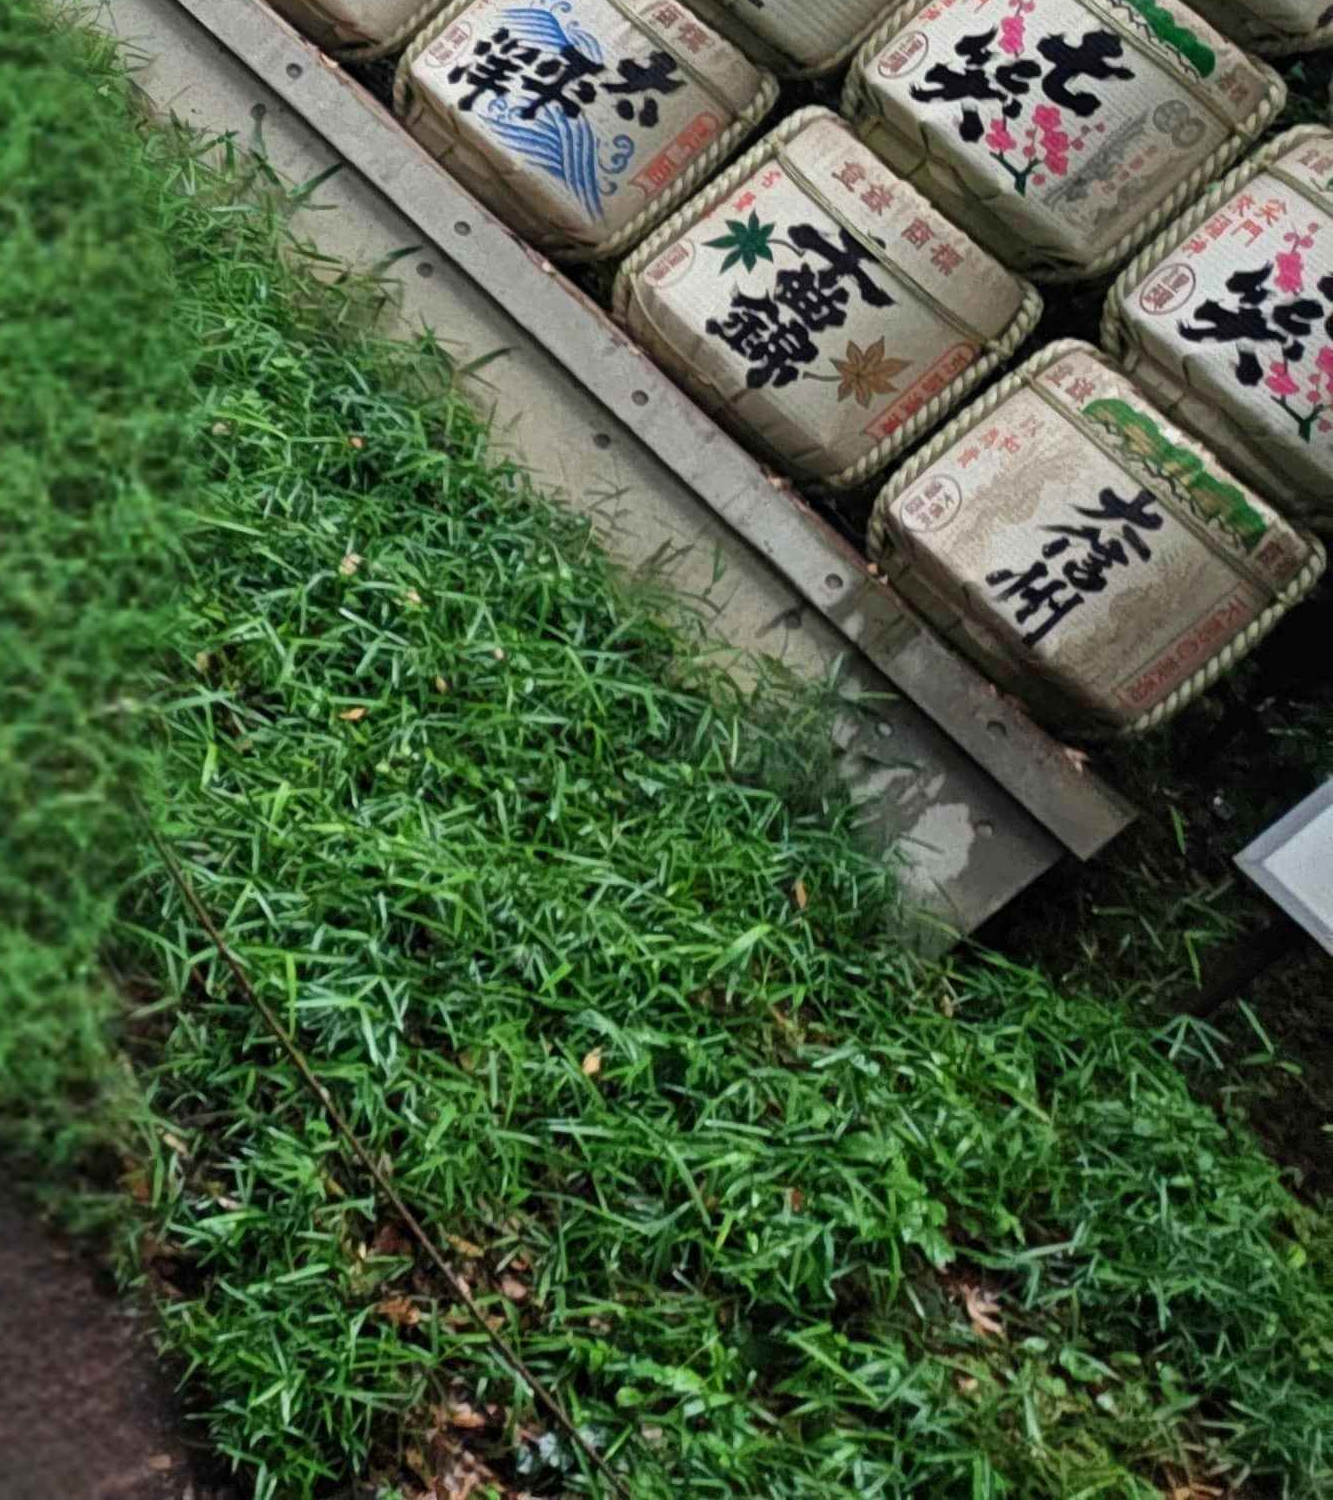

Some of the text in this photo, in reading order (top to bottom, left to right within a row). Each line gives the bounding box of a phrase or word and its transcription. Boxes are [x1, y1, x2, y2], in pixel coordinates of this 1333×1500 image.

[449, 29, 686, 127] 太平洋
[911, 30, 1135, 142] 七笑
[991, 488, 1162, 650] 大信州
